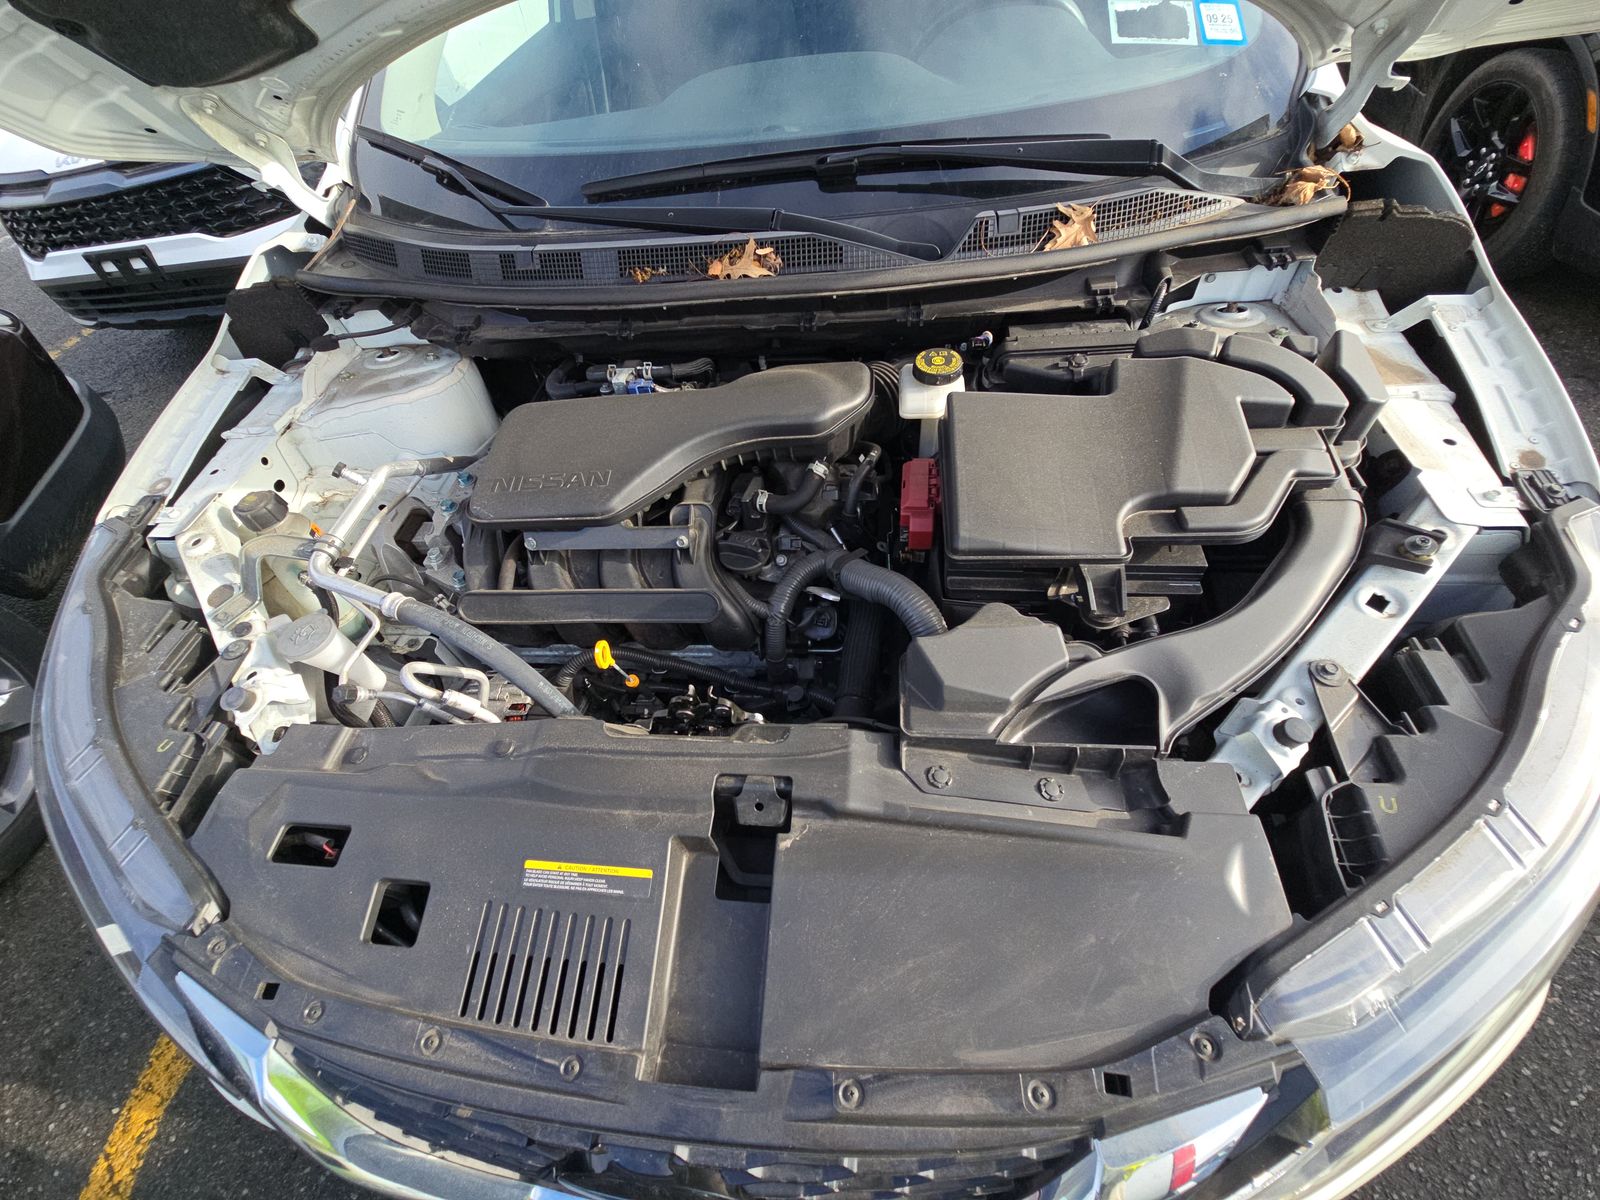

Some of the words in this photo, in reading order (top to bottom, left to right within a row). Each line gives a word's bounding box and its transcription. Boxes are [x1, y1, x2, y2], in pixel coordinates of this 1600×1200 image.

[1206, 14, 1218, 23] 09
[1220, 14, 1233, 24] 25
[491, 469, 612, 493] NISSAN
